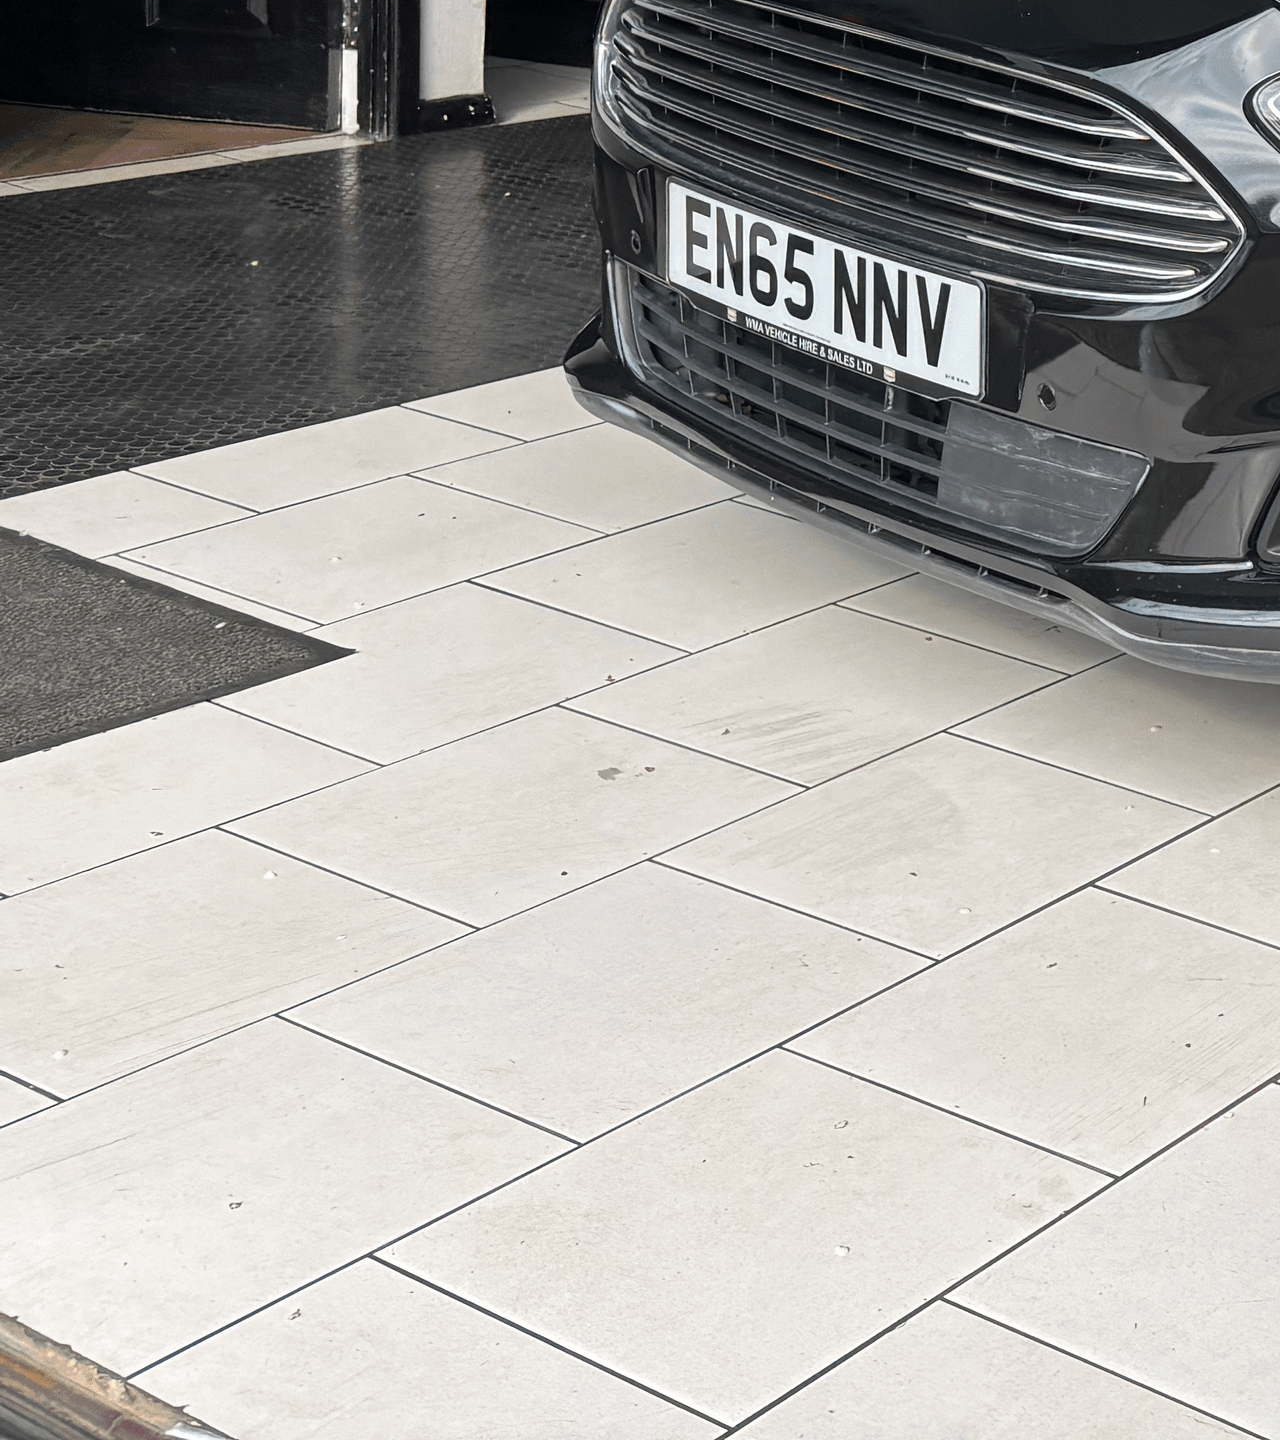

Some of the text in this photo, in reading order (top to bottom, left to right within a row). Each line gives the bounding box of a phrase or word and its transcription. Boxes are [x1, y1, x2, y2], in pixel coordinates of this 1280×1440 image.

[685, 194, 951, 368] EN65 NNV
[764, 323, 798, 348] VEHICLE
[799, 337, 819, 356] HIRE
[819, 346, 827, 358] &
[827, 348, 856, 369] SALES
[856, 360, 873, 375] LTD
